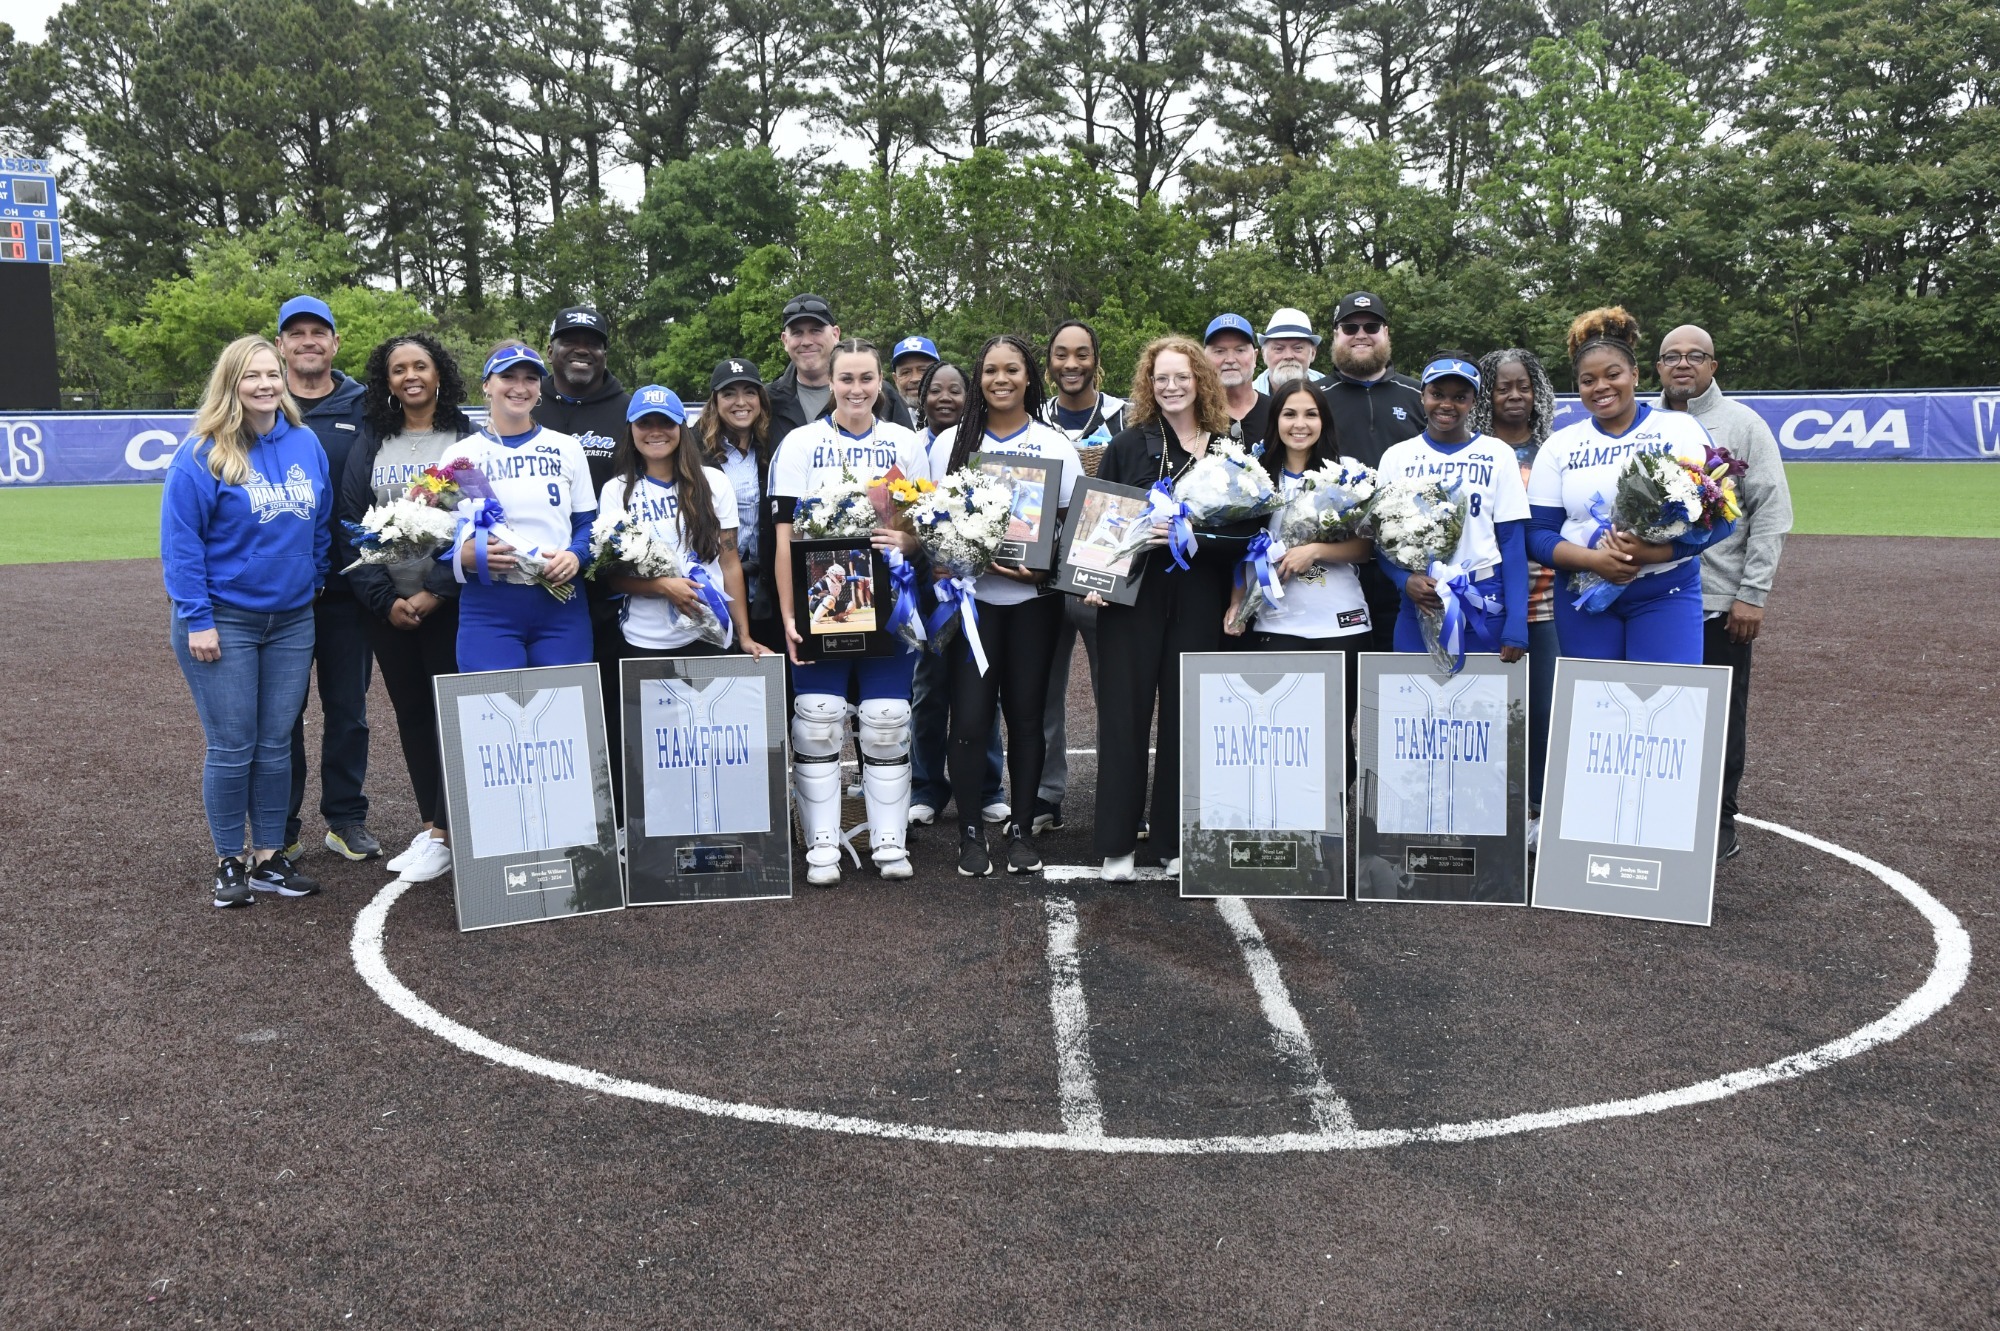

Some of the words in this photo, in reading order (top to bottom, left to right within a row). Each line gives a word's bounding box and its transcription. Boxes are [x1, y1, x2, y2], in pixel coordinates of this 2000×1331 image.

[11, 222, 22, 239] 0
[13, 242, 24, 259] 0
[729, 361, 744, 373] LA
[643, 390, 668, 406] HU
[1393, 406, 1407, 420] HU
[1779, 409, 1911, 450] CAA
[535, 445, 561, 456] CAA
[873, 440, 896, 448] CAA
[1018, 443, 1042, 451] CAA
[1468, 453, 1494, 462] CAA
[479, 455, 562, 482] AMPTON
[250, 483, 313, 508] HAMPTON
[547, 483, 561, 507] 9
[1470, 492, 1482, 517] 8
[269, 502, 300, 510] SOFTBALL
[656, 724, 749, 769] HAMPTON
[1213, 725, 1311, 768] HAMPTON
[1394, 717, 1491, 763] HAMPTON
[478, 738, 575, 788] HAMPTON
[1586, 731, 1687, 781] HAMPTON
